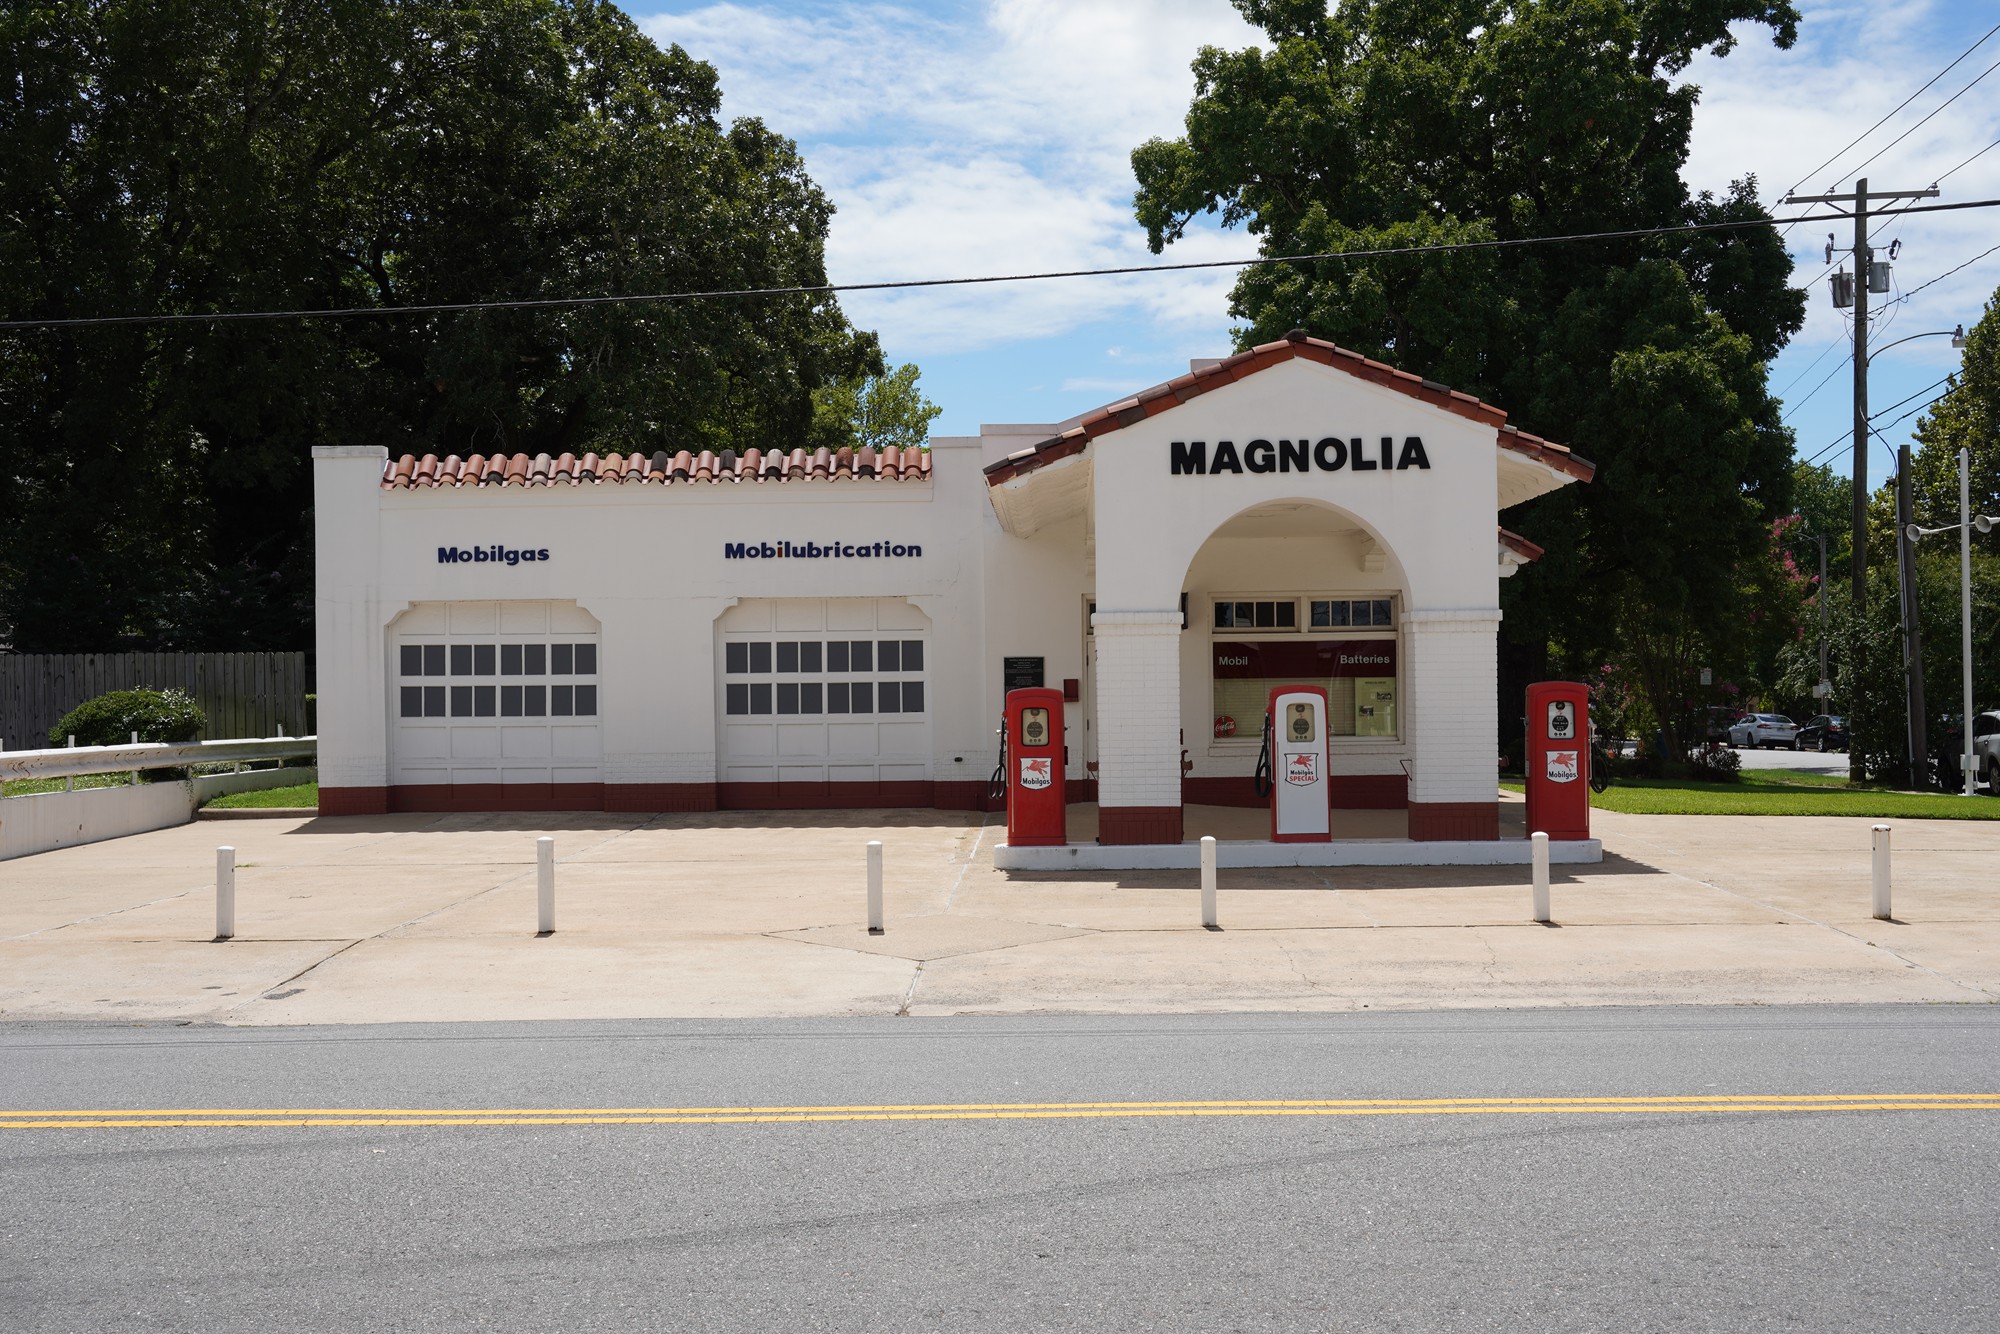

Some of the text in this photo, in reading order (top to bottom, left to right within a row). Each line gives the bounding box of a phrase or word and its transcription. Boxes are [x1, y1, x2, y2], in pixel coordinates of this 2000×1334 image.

[1171, 437, 1431, 475] MAGNOLIA
[438, 545, 550, 566] Mobilgas
[725, 541, 922, 559] Mobilubrication
[1218, 654, 1390, 666] Mobil Batteries
[1022, 778, 1050, 786] Mobilgas
[1549, 771, 1576, 779] Mobilgas
